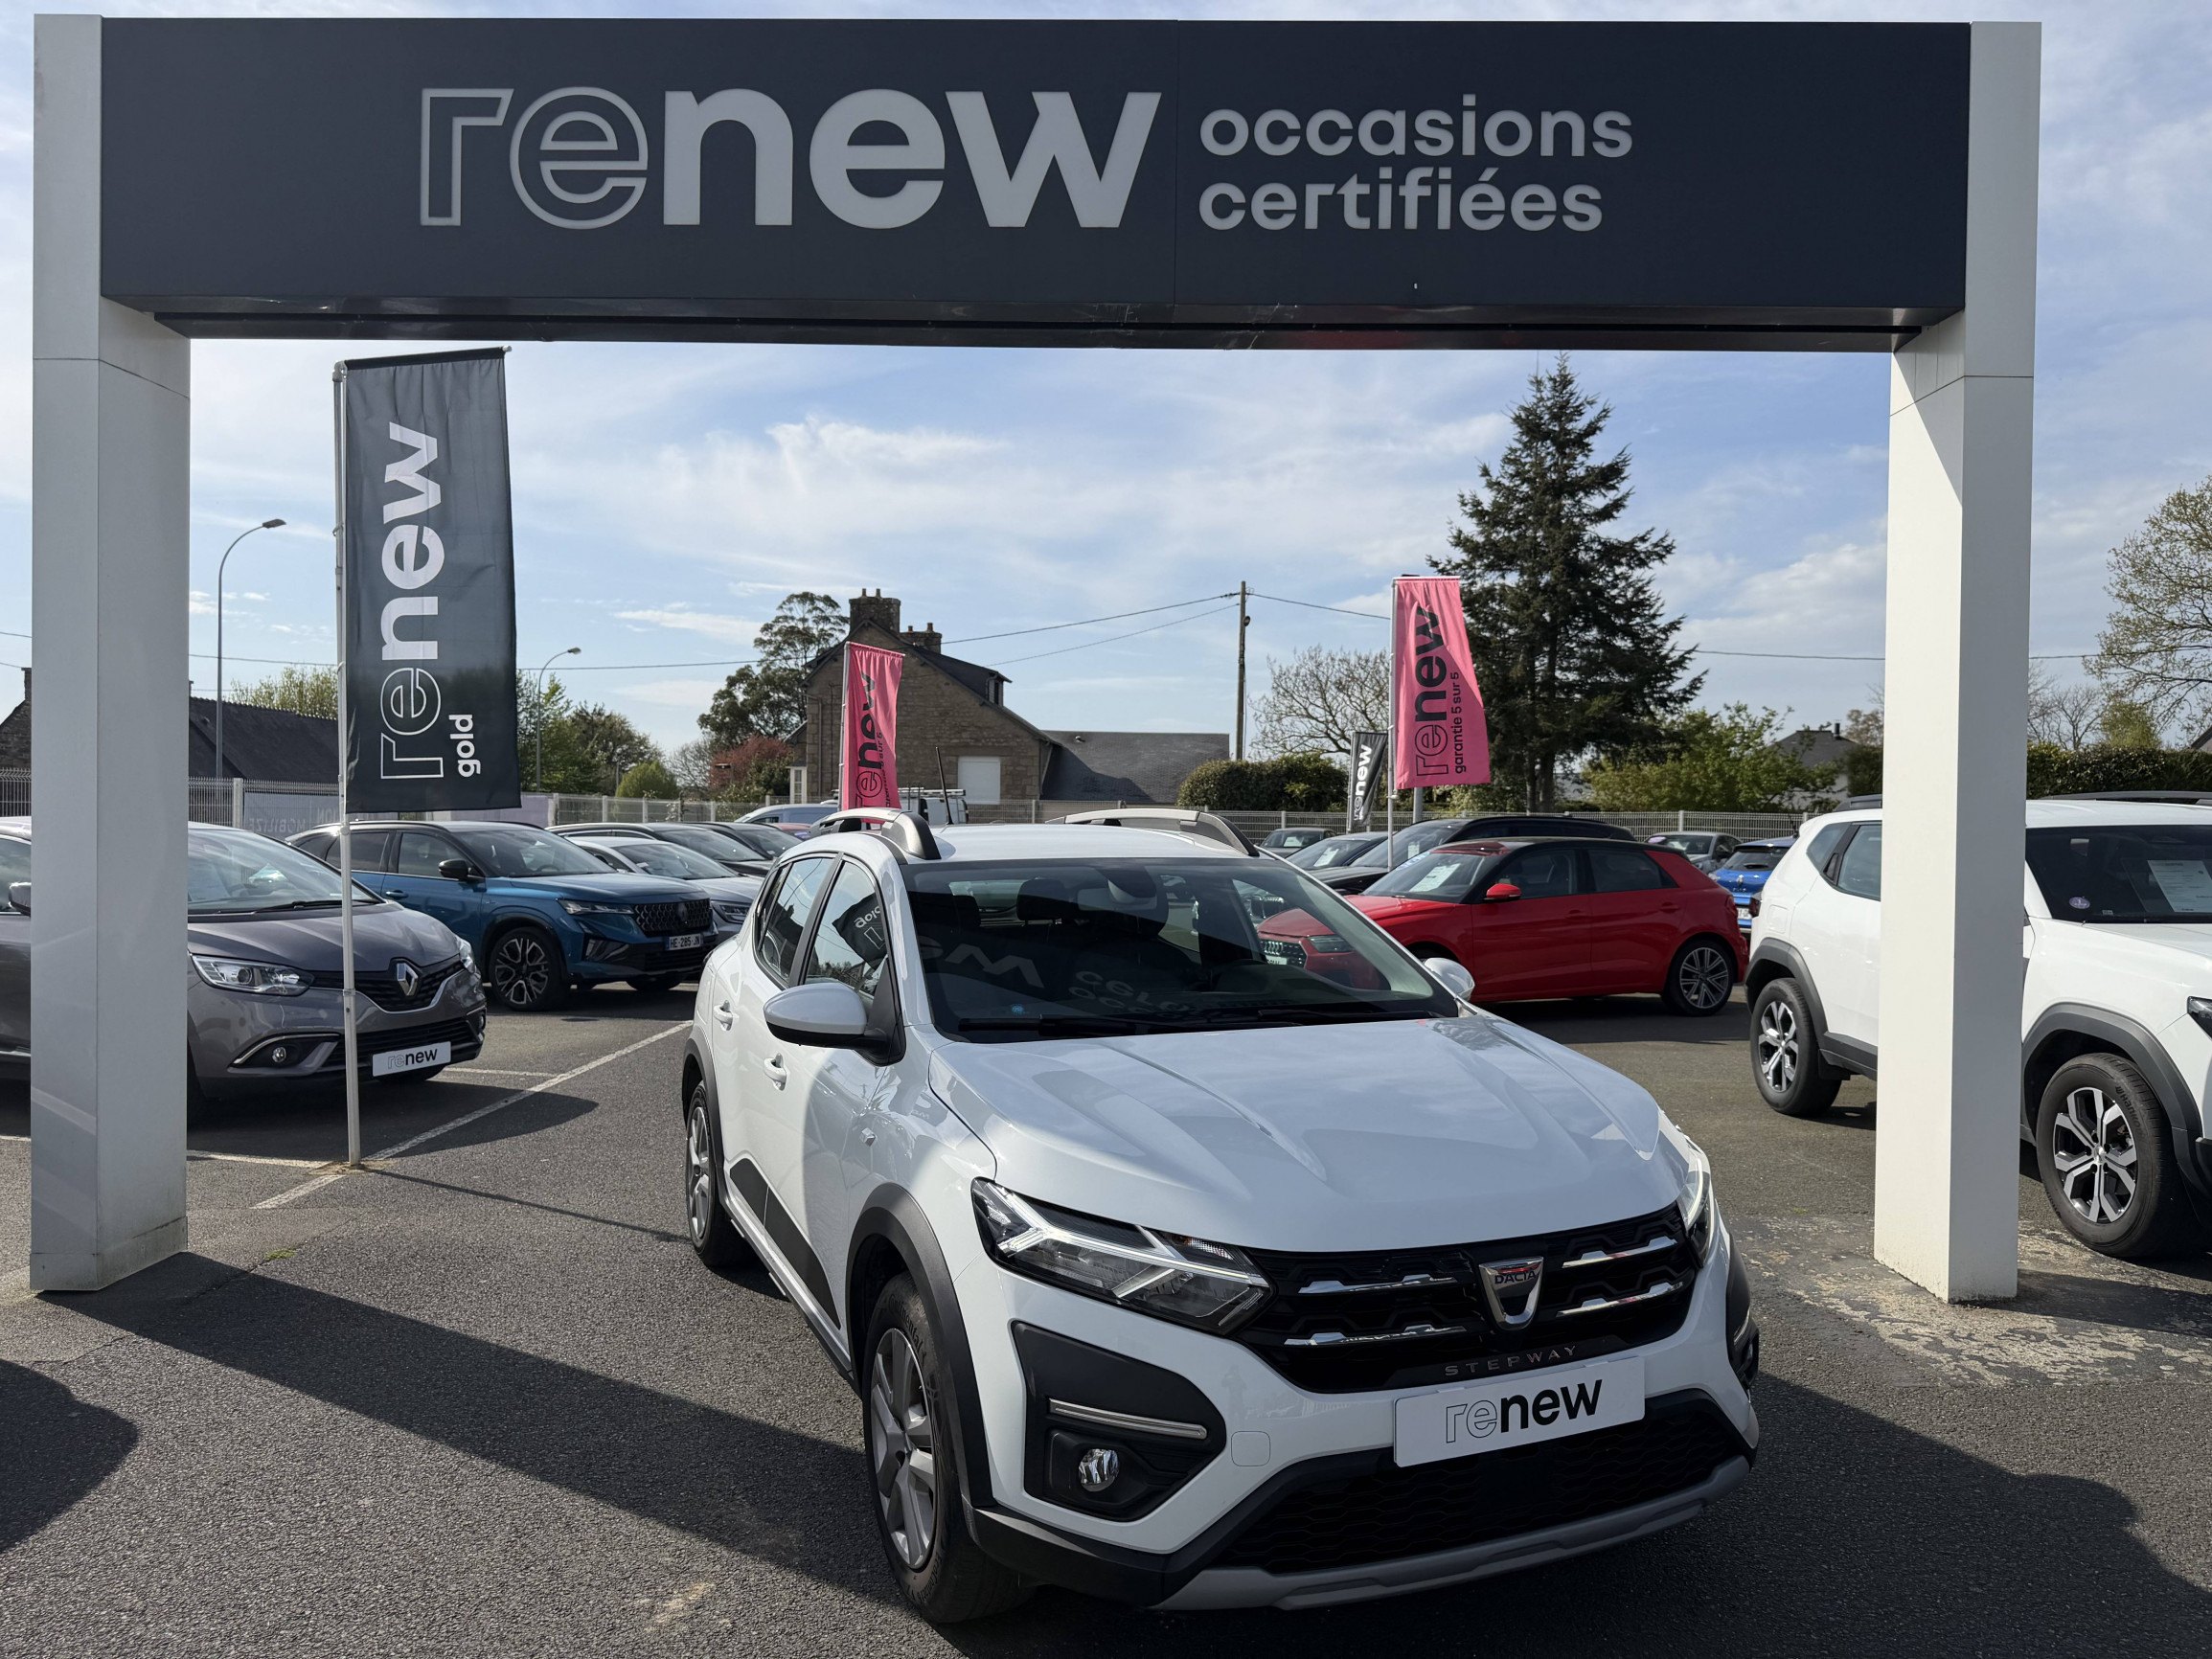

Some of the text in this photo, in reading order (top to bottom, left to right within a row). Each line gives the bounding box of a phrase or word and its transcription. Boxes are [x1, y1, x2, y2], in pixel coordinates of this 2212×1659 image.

[421, 86, 1162, 229] renew
[1199, 93, 1633, 158] occasions
[1198, 166, 1603, 232] certifiées
[380, 420, 445, 779] renew
[1414, 605, 1449, 777] renew
[1450, 671, 1467, 775] garantie 5 sur 5
[448, 714, 481, 778] gold
[387, 1048, 438, 1070] renew
[1494, 1270, 1539, 1285] DACIA
[1444, 1345, 1577, 1376] STEPWAY
[1445, 1378, 1604, 1444] renew
